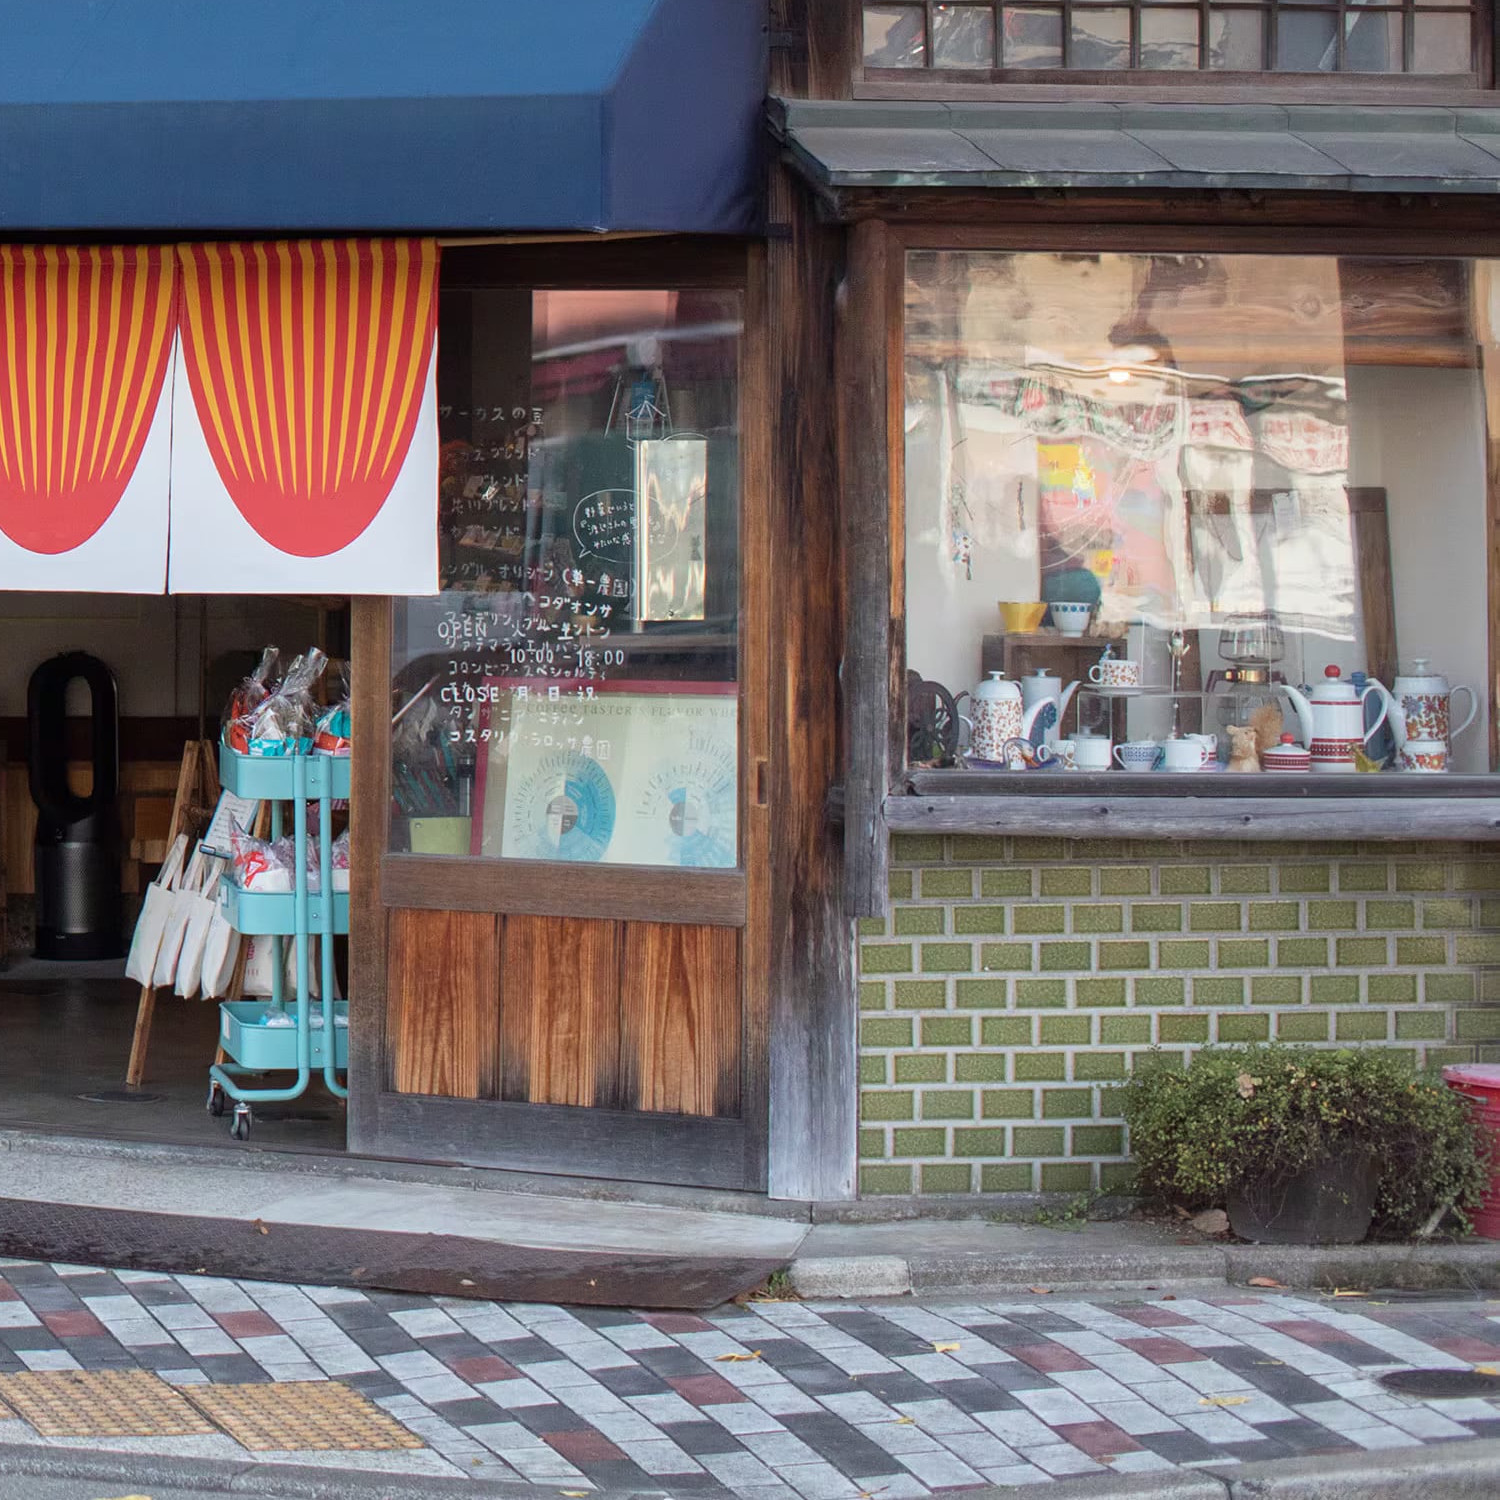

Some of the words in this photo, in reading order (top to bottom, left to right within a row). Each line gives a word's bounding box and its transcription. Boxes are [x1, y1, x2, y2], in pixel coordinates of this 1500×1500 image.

[438, 622, 488, 639] OPEN
[511, 648, 555, 666] 10:00
[576, 648, 625, 668] 18:00
[440, 685, 501, 703] CLOSE
